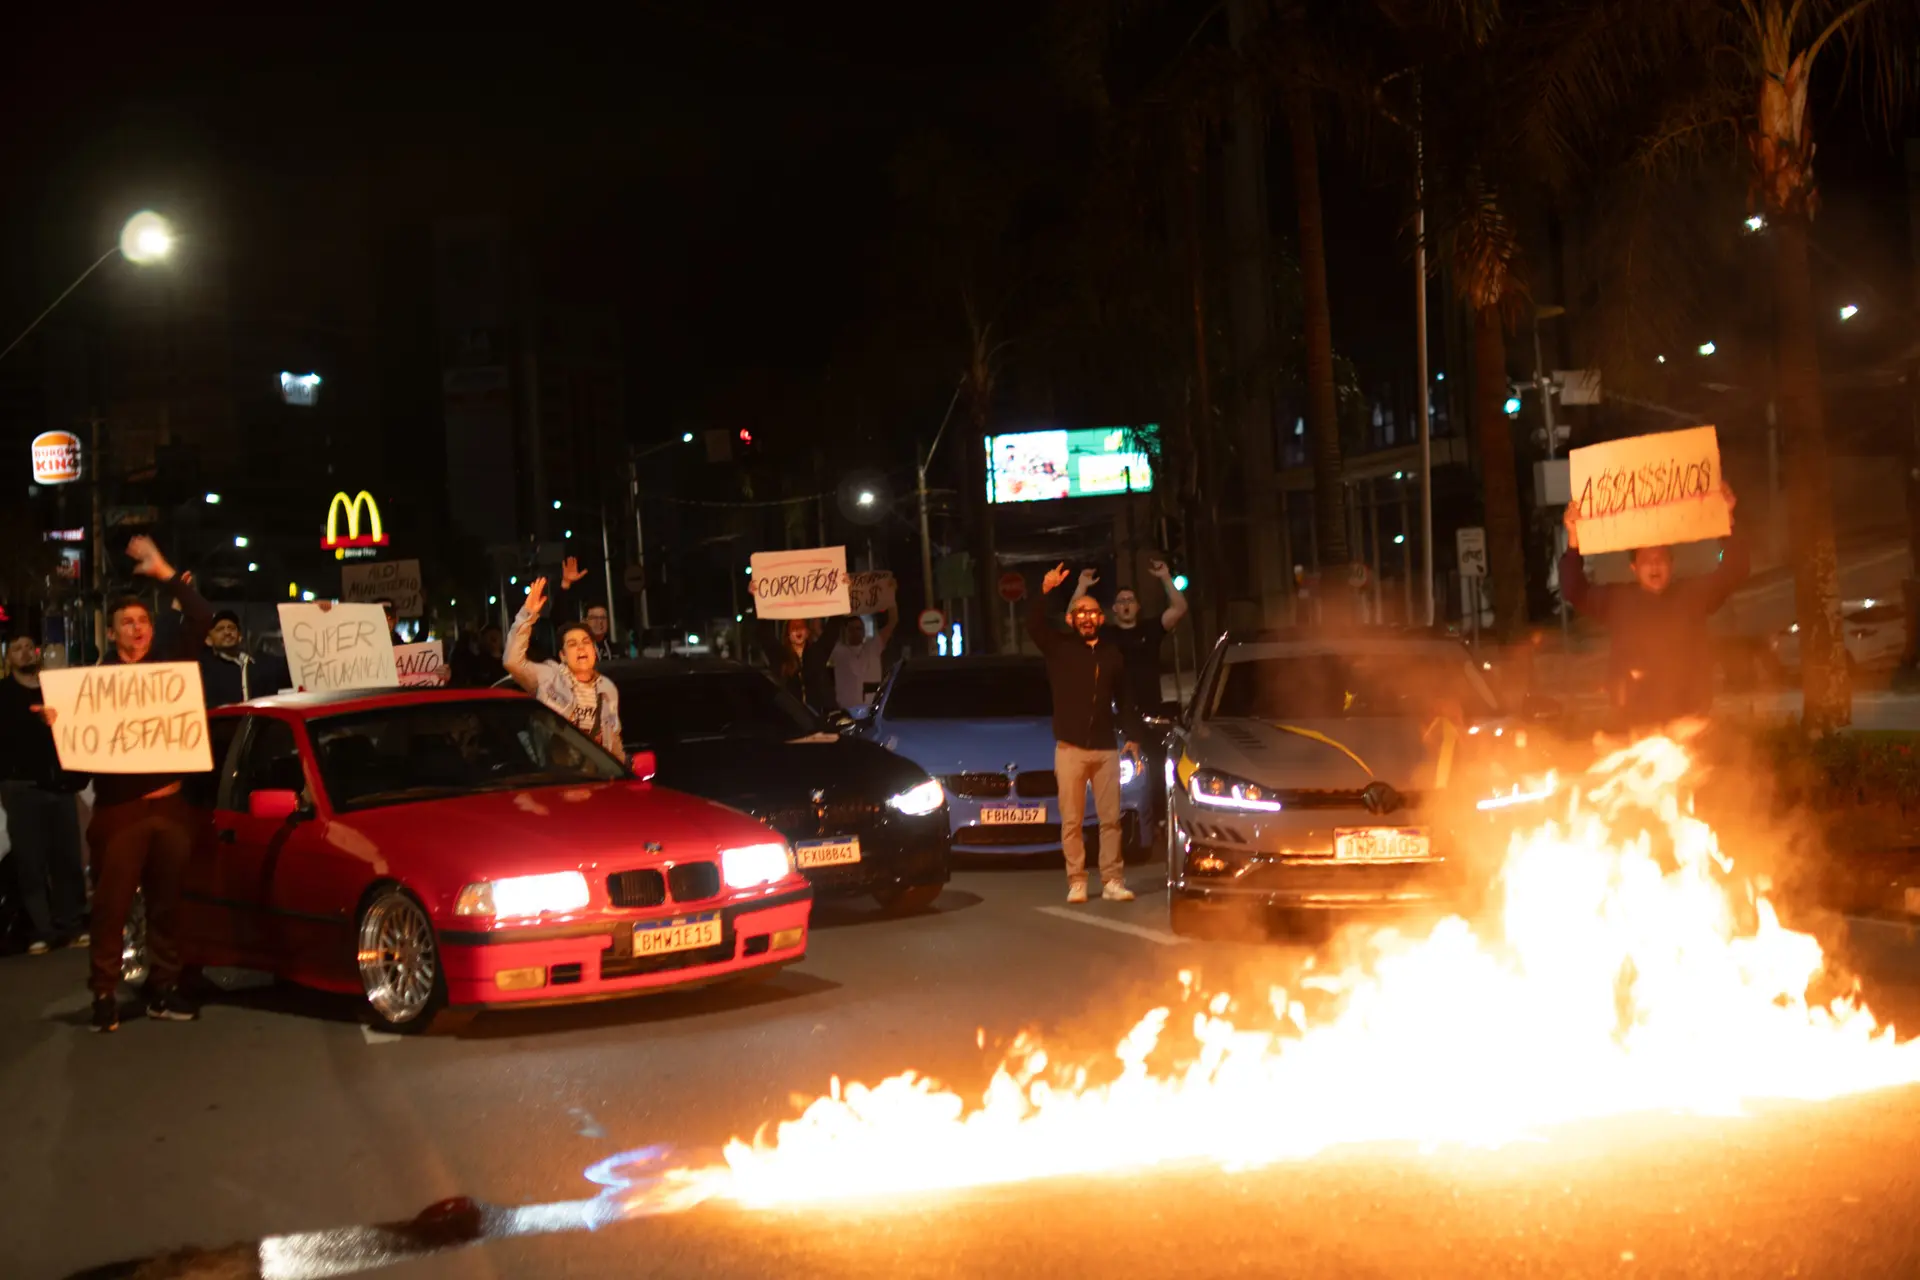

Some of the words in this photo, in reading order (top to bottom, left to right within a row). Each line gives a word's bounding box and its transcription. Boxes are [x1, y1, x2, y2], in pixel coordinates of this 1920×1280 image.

[293, 620, 377, 662] SUPER
[61, 723, 99, 755] NO
[107, 710, 203, 758] ASFALTO
[642, 924, 713, 952] BMW1E15
